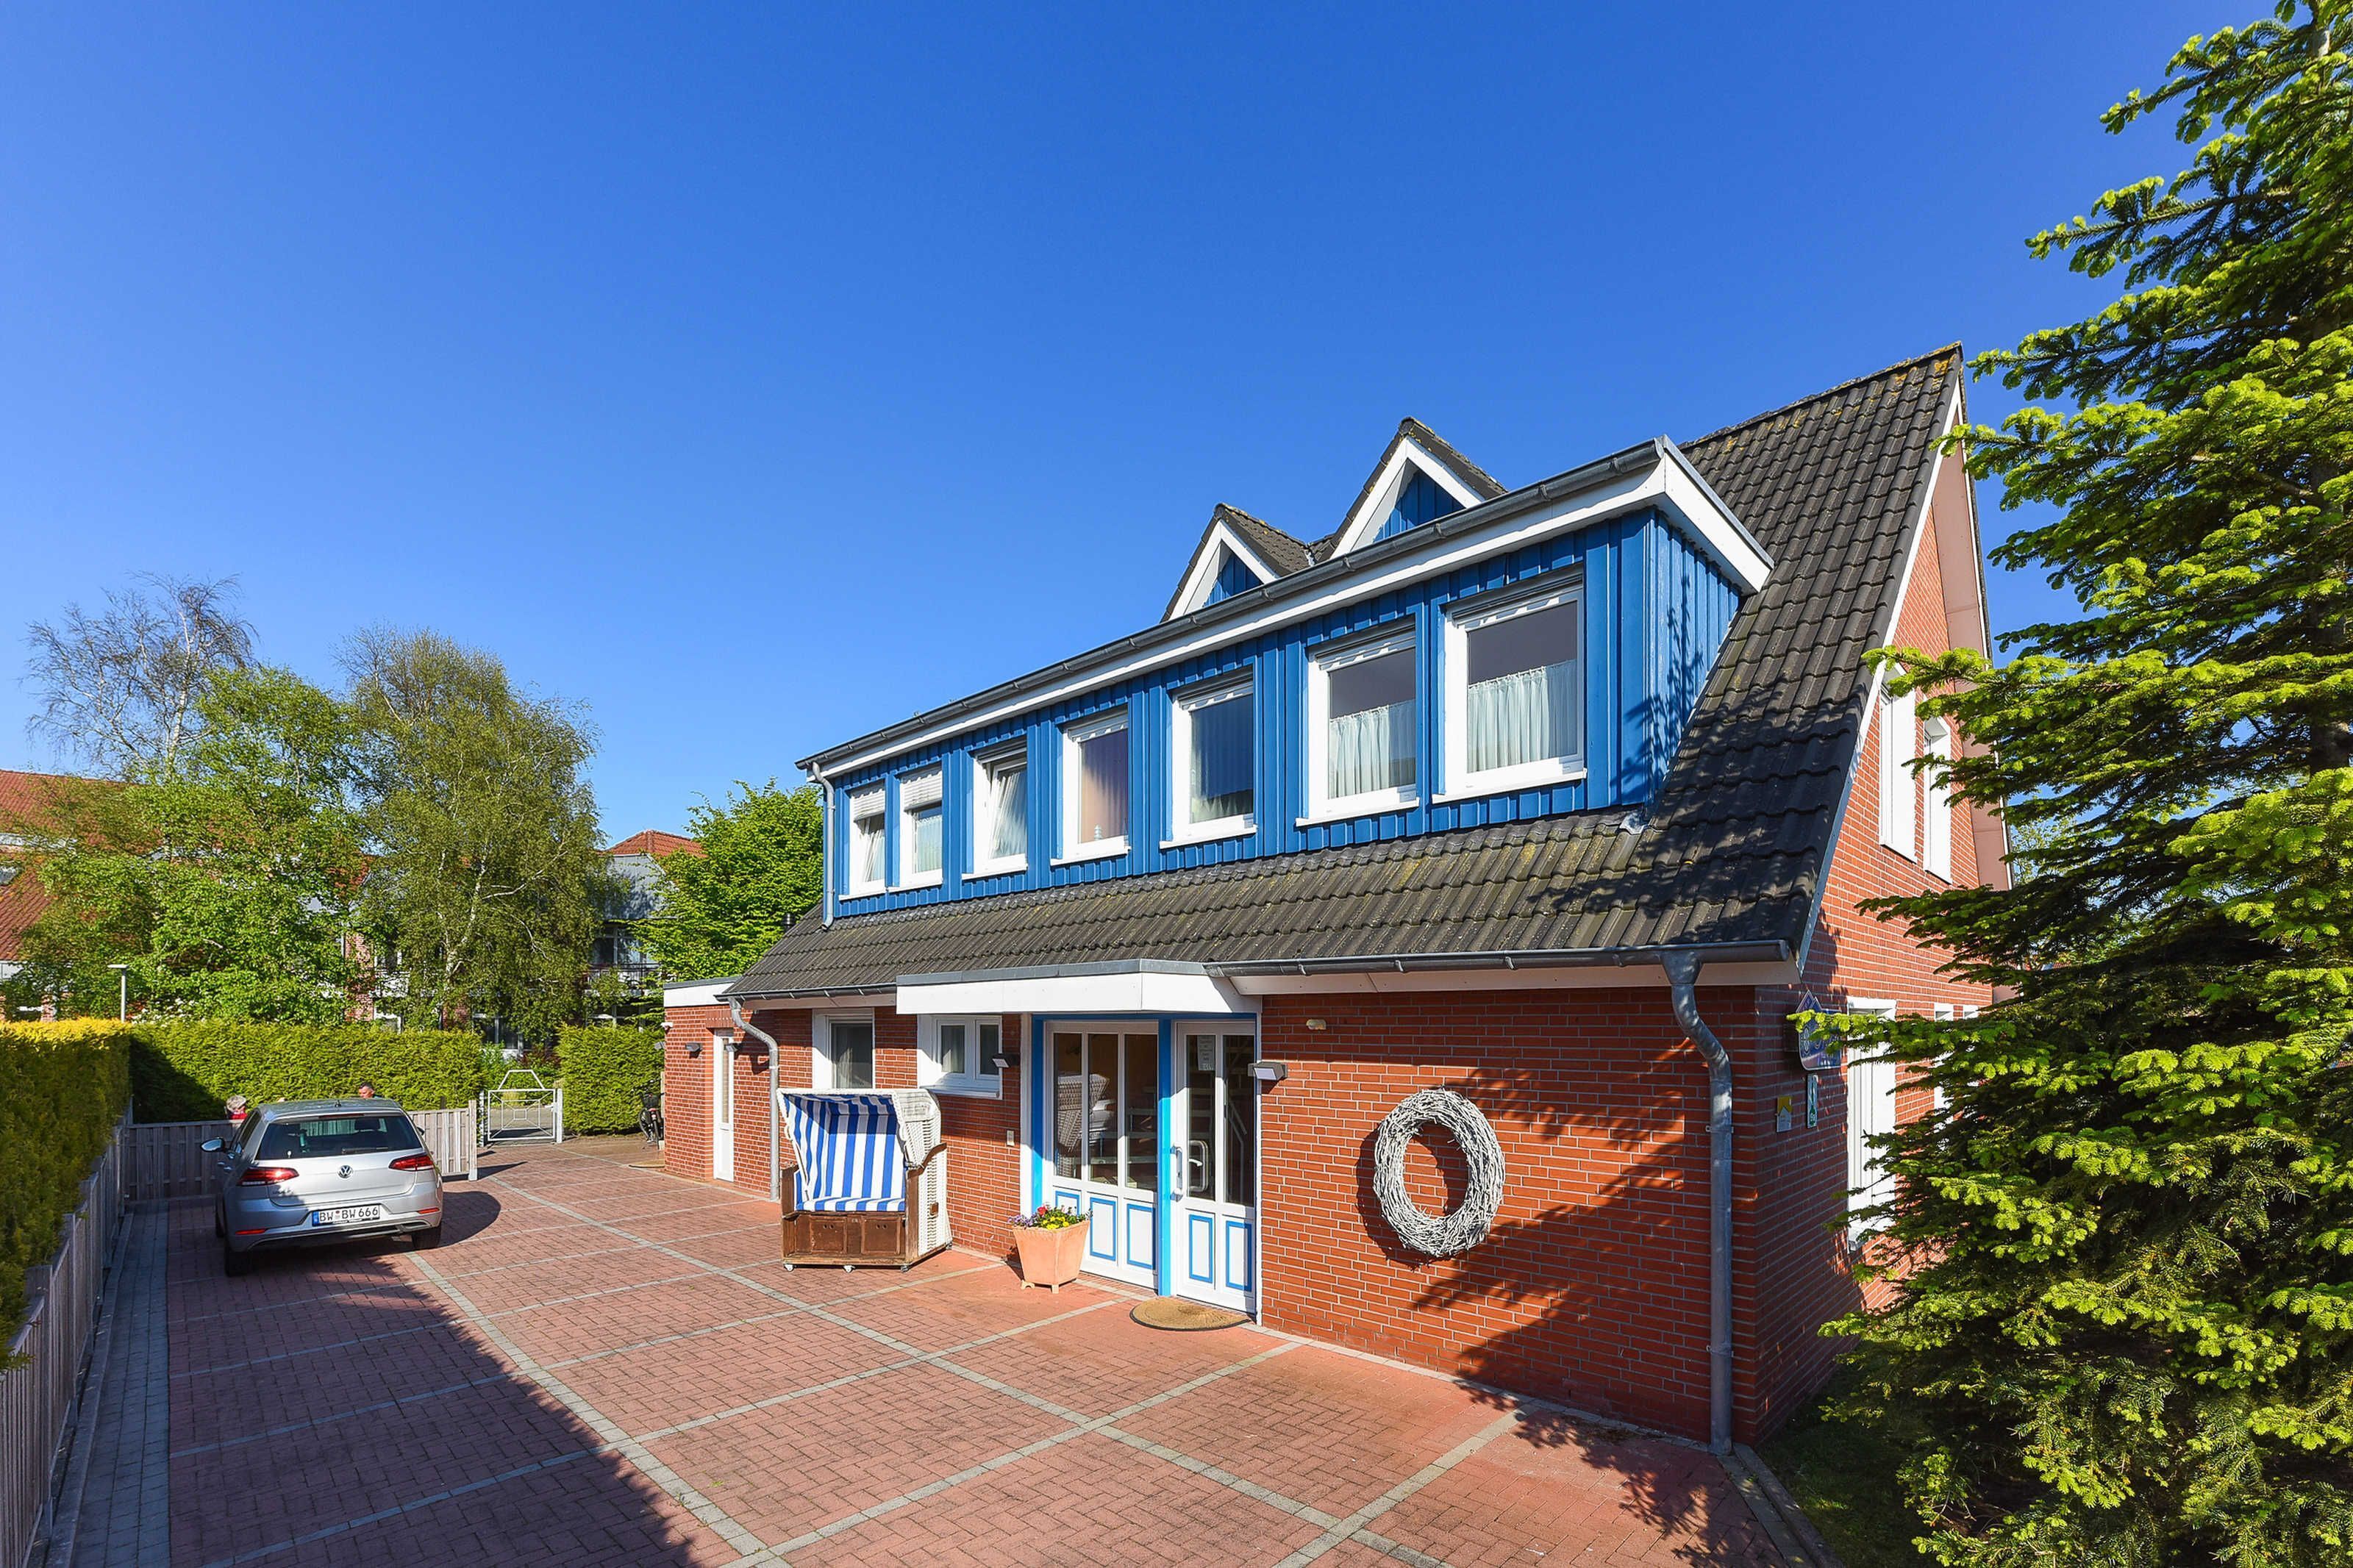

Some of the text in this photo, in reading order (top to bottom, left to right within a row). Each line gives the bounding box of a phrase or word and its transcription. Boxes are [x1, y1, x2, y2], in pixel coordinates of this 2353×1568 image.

[319, 1211, 333, 1222] BW
[342, 1209, 356, 1219] BW
[358, 1207, 378, 1217] 666
